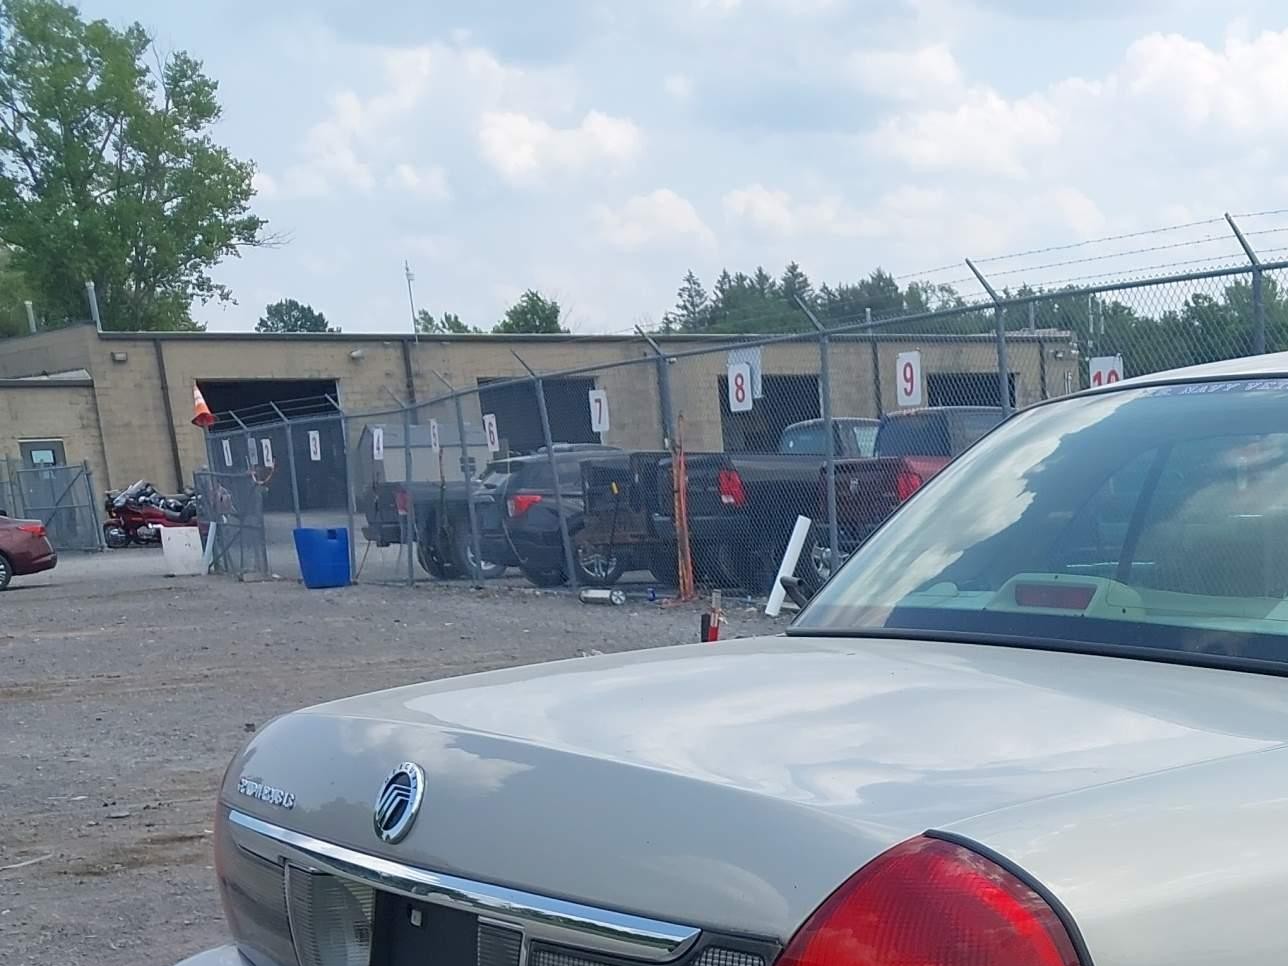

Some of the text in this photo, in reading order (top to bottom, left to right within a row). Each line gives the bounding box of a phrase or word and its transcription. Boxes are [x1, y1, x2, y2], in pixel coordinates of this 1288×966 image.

[734, 372, 746, 403] 8
[902, 361, 914, 397] 9
[594, 397, 603, 425] 7
[311, 436, 319, 456] 3
[374, 433, 381, 455] 4
[486, 422, 496, 446] 6
[264, 444, 271, 463] 2
